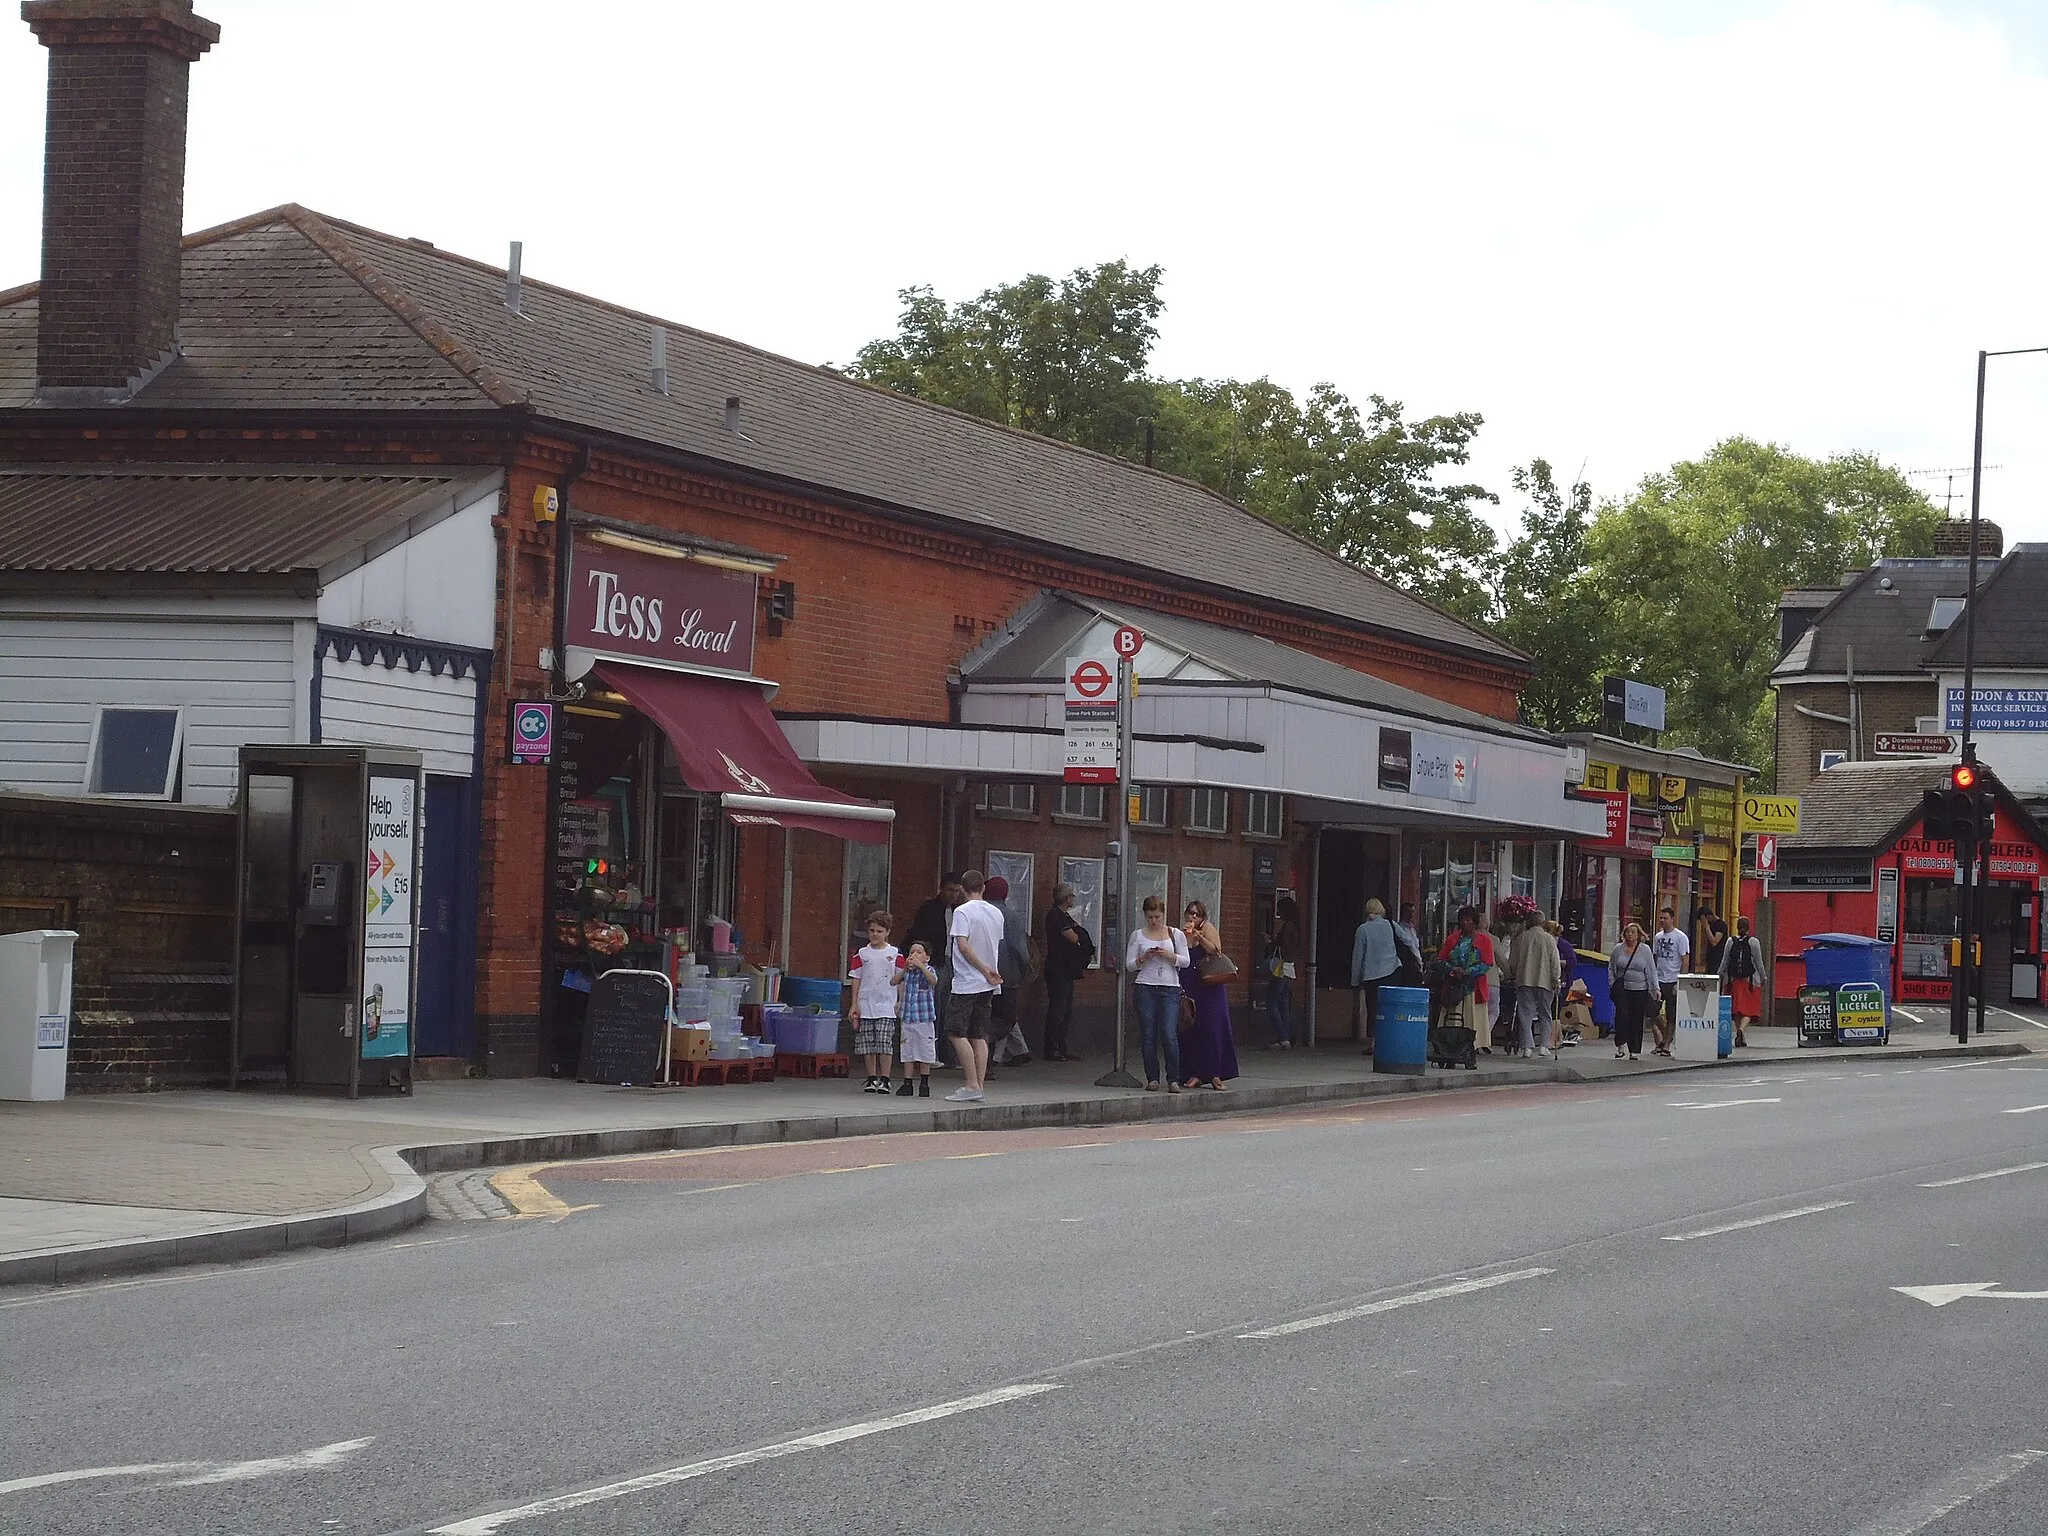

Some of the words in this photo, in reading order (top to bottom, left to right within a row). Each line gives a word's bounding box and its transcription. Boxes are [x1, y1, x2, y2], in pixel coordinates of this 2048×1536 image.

[588, 569, 663, 643] Tess
[673, 608, 737, 654] Local
[1121, 631, 1135, 652] B
[2005, 691, 2014, 701] &
[1951, 703, 2003, 712] INSRANCE
[2003, 704, 2047, 713] SERVICES
[1949, 718, 1973, 727] TE:
[1976, 719, 2001, 729] (020)
[2003, 719, 2026, 728] 8857
[1891, 736, 1923, 744] Downham
[515, 742, 549, 752] payzone
[1416, 752, 1435, 778] Grove
[1436, 756, 1449, 780] Park
[559, 787, 577, 800] Bread
[370, 795, 392, 819] Help
[369, 820, 409, 841] yourself.
[1906, 857, 1918, 868] Tel
[1918, 857, 1936, 869] 0800
[1937, 858, 1950, 870] 955
[2013, 861, 2027, 874] 003
[2027, 862, 2038, 874] 213
[394, 877, 408, 894] £15
[1903, 983, 1927, 995] SHOE
[1850, 993, 1869, 1002] OFF
[1803, 1005, 1831, 1014] CASH
[1840, 1001, 1880, 1011] LICENCE
[1804, 1019, 1832, 1030] HERE
[1857, 1015, 1881, 1024] oyster
[1849, 1028, 1875, 1036] News
